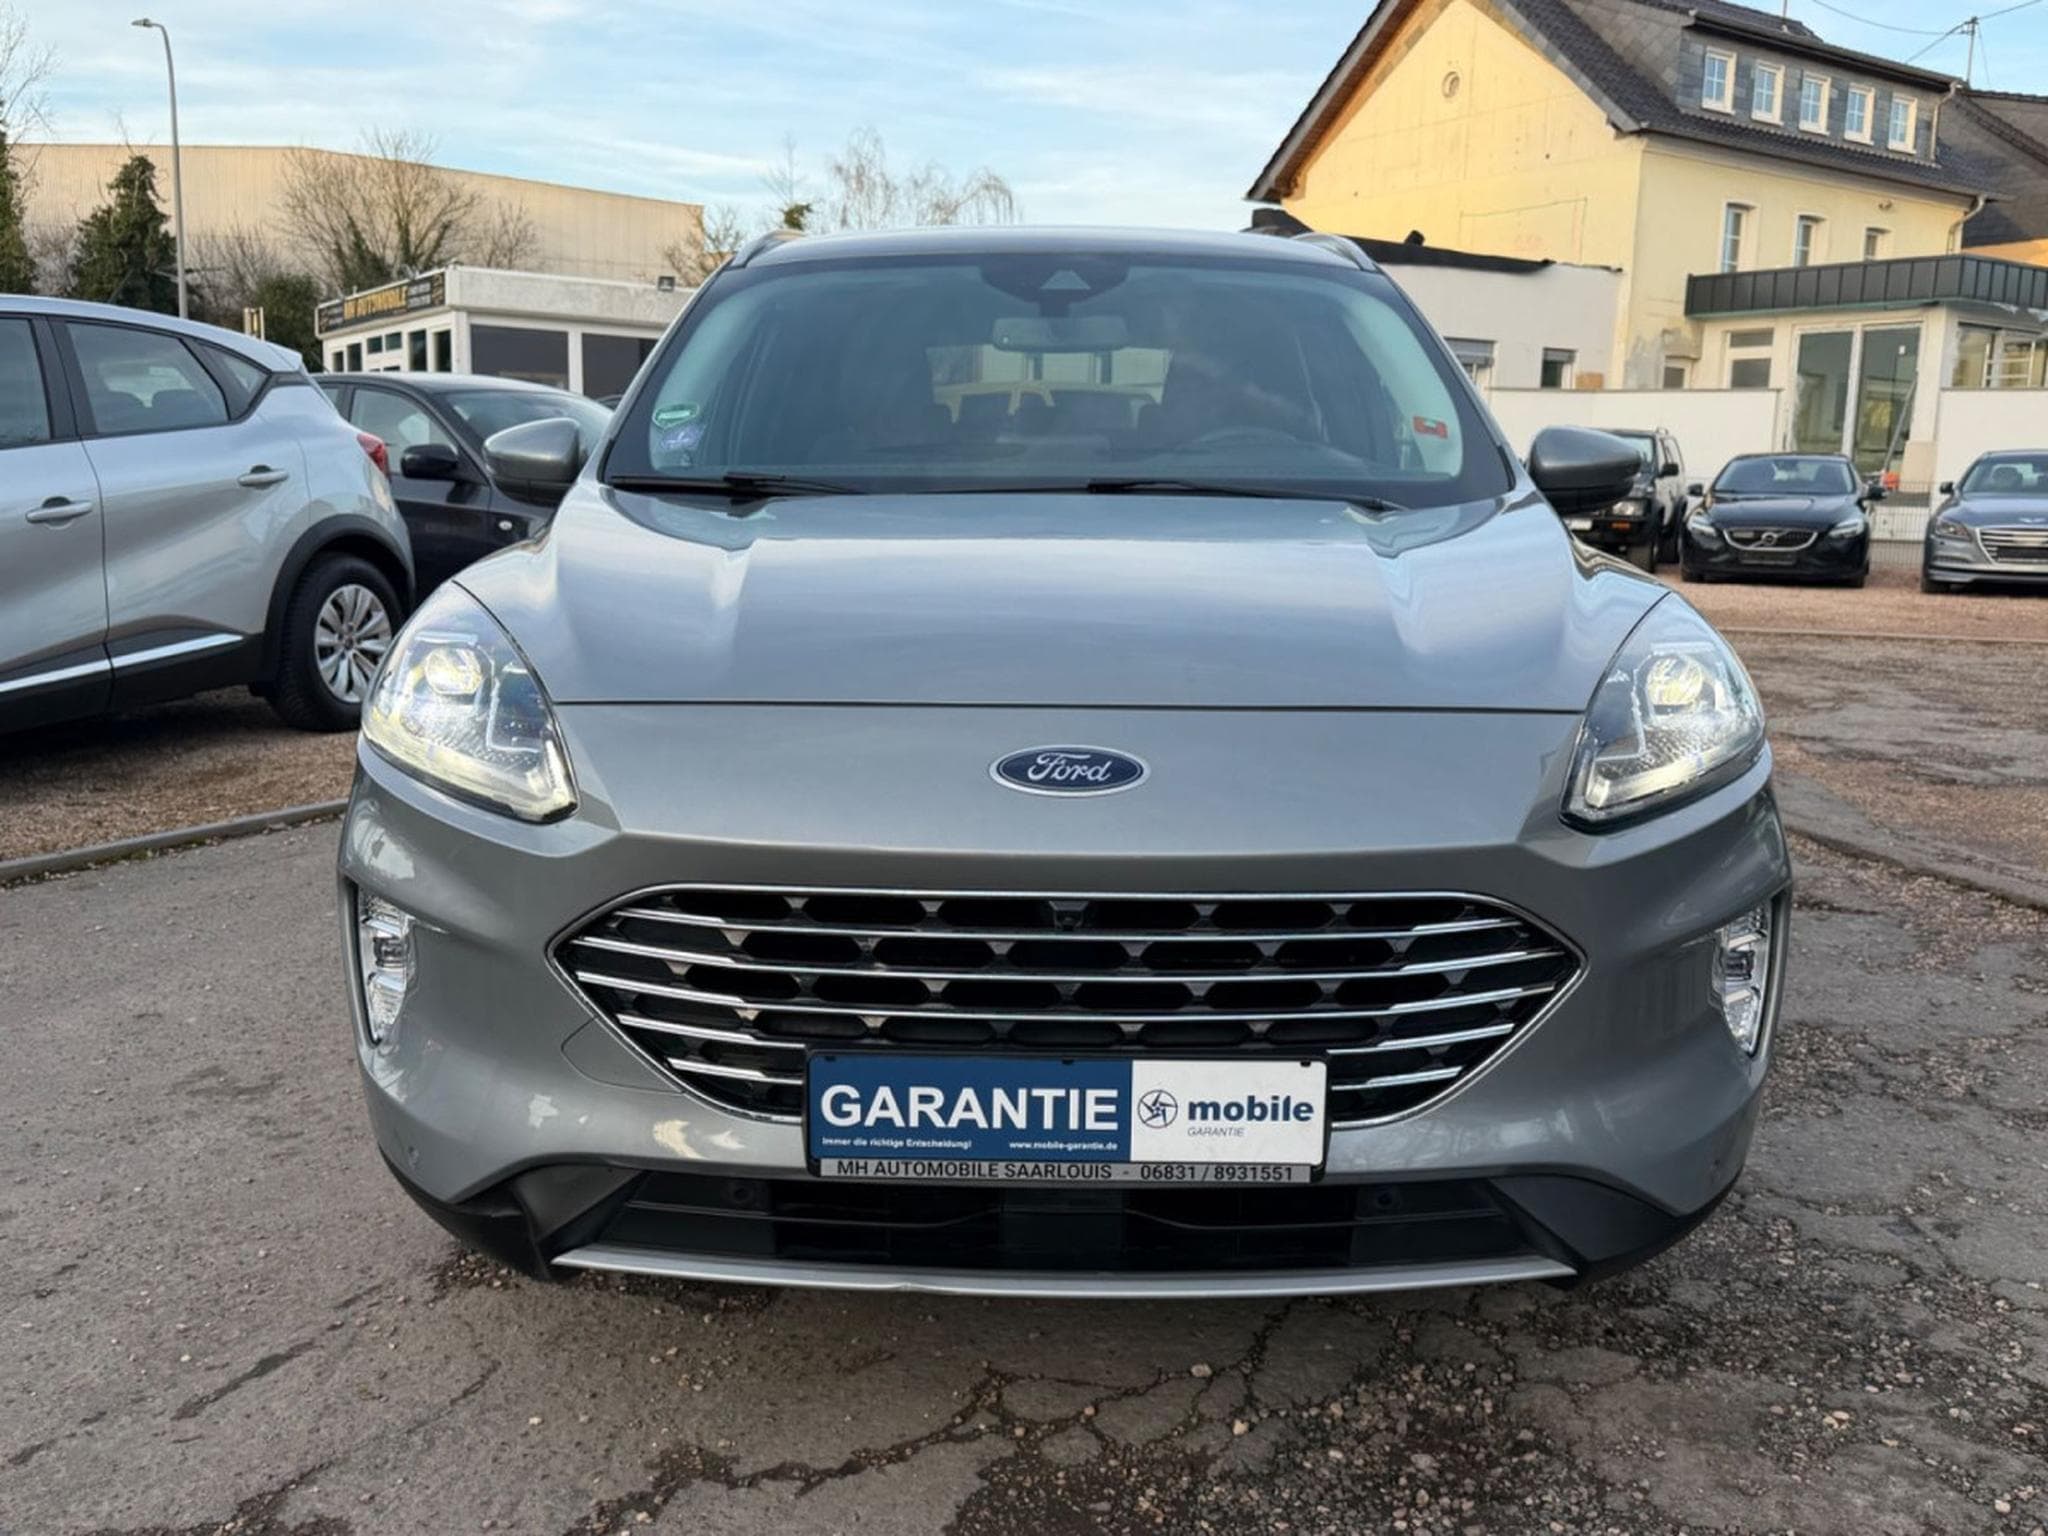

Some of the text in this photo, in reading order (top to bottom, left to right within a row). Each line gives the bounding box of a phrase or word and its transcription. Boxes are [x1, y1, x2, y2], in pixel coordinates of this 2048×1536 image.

[1027, 752, 1112, 781] Ford
[820, 1084, 1119, 1131] GARANTIE
[1188, 1095, 1314, 1122] mobile
[1187, 1127, 1244, 1137] GARANTIE
[822, 1137, 972, 1150] Immer die richtige Entscheidung!
[1009, 1140, 1118, 1151] www.mobile-garantie.de
[837, 1161, 868, 1175] MH
[875, 1162, 999, 1178] AUTOMOBILE
[1005, 1164, 1112, 1179] SAARLOUIS
[1140, 1165, 1196, 1181] 06831
[1214, 1166, 1293, 1182] 8931551
